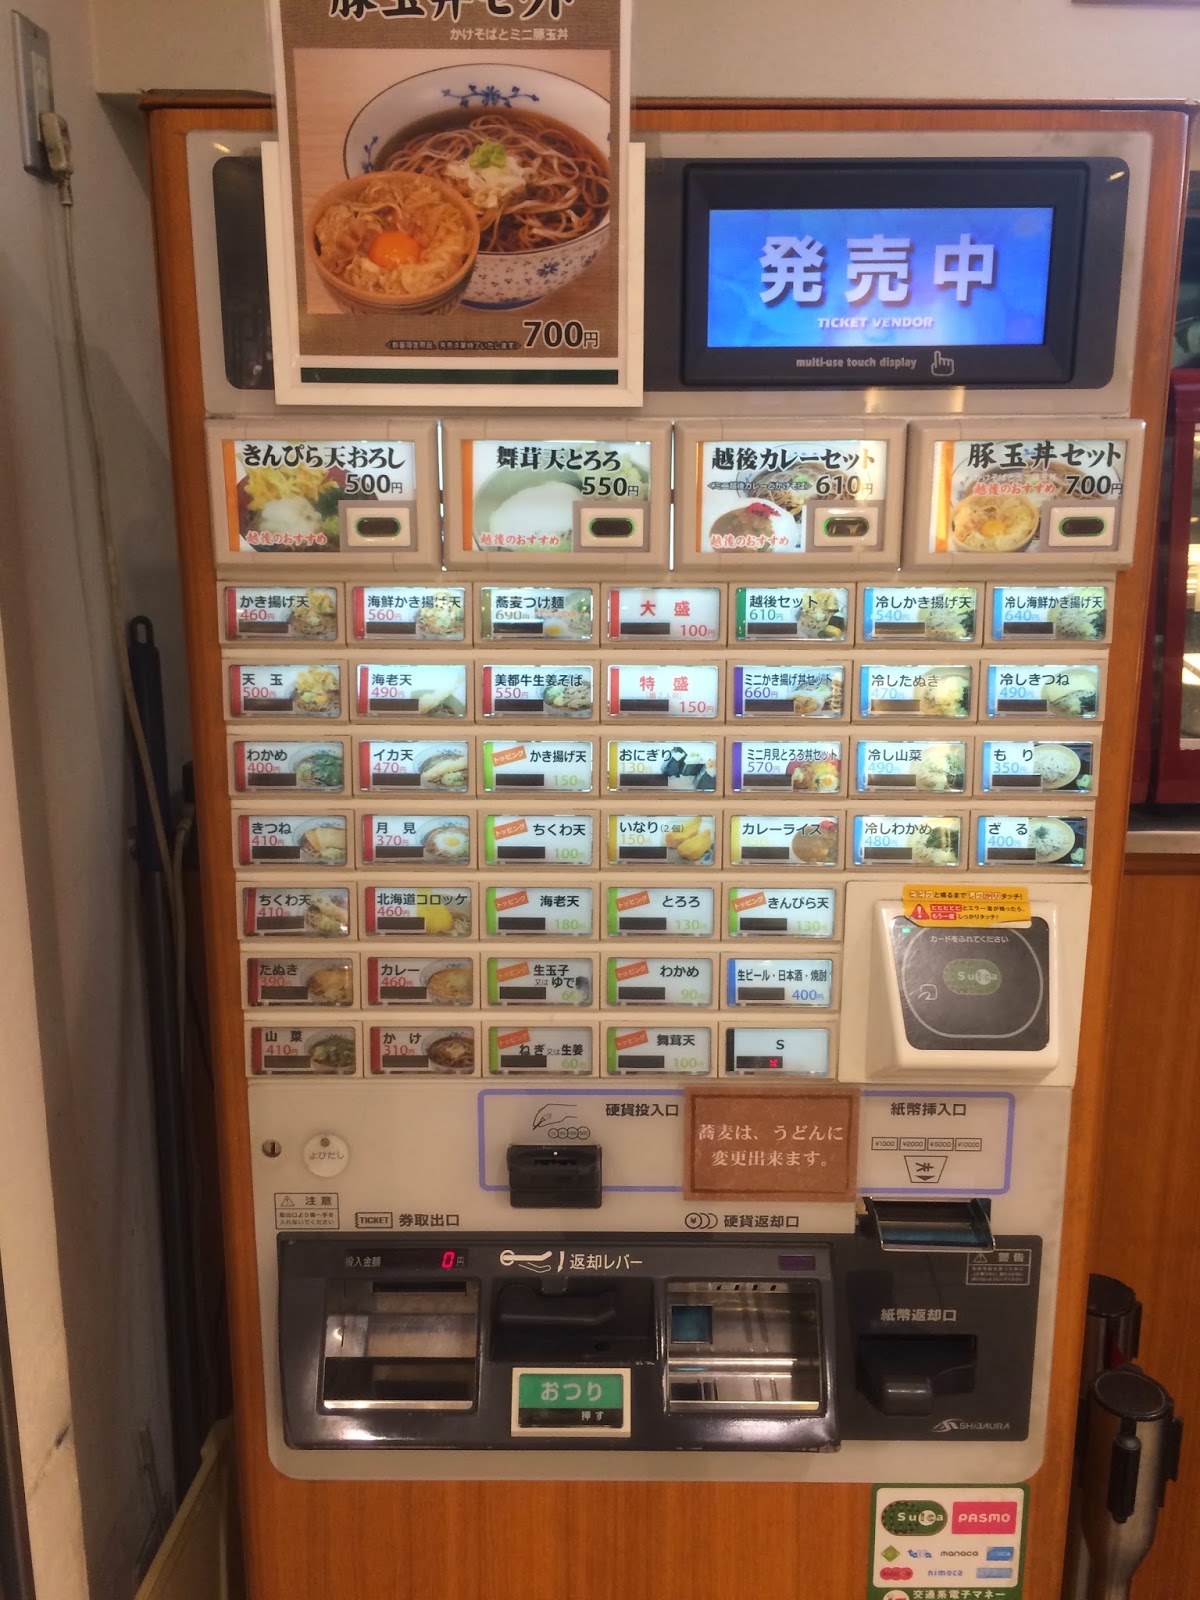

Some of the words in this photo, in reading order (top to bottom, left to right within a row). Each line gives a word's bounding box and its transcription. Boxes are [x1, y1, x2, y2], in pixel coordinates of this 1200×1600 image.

[758, 233, 997, 303] 発売中
[817, 317, 868, 329] TICKET
[872, 317, 934, 329] VENDOR
[523, 320, 600, 349] 700円
[795, 357, 844, 368] multi-use
[846, 357, 877, 368] touch
[879, 357, 917, 370] display
[243, 443, 406, 470] きんぴら天おろし
[496, 445, 622, 472] 舞茸天とろろ
[711, 441, 876, 471] 越後カレーセット
[967, 440, 1122, 470] 豚玉丼セット
[343, 473, 404, 495] 500円
[580, 475, 640, 498] 550円
[814, 474, 874, 496] 610円
[974, 482, 1057, 496] 越後のおすすめ
[1065, 475, 1123, 496] 700円
[246, 532, 328, 545] 越後のおすすめ
[479, 532, 560, 546] 越後のおすすめ
[709, 533, 790, 548] 越後のおすすめ
[239, 595, 310, 609] かき揚げ天
[367, 595, 462, 609] 海鮮かき揚げ天
[749, 595, 819, 608] 越後セット
[875, 595, 973, 610] 冷しかき揚げ天
[1004, 595, 1103, 610] 冷し海鮮かき揚げ天
[240, 609, 275, 621] 460円
[367, 609, 401, 621] 560円
[639, 600, 691, 617] 大盛
[749, 609, 784, 621] 610円
[680, 624, 716, 637] 100円
[242, 673, 284, 686] 天玉
[371, 673, 413, 686] 海老天
[494, 673, 583, 687] 美都牛生姜そば
[639, 675, 689, 692] 特盛
[744, 673, 833, 687] ミニかき揚げ丼セット
[871, 674, 940, 687] 冷したぬき
[999, 673, 1070, 686] 冷しきつね
[242, 687, 276, 698] 500円
[495, 687, 529, 699] 550円
[744, 687, 779, 699] 660円
[679, 701, 714, 713] 150円
[246, 749, 288, 761] わかめ
[373, 749, 414, 761] イカ天
[529, 750, 587, 763] かき揚げ天
[619, 749, 672, 762] おにぎり
[746, 748, 838, 761] ミニ月見とろろ丼セット
[867, 749, 923, 762] 冷し山菜
[993, 749, 1034, 762] もり
[247, 762, 282, 773] 400円
[747, 762, 781, 773] 570円
[251, 822, 292, 834] きつね
[376, 821, 417, 835] 月見
[532, 823, 586, 837] ちくわ天
[742, 822, 822, 836] カレーライス
[864, 822, 933, 836] 冷しわかめ
[987, 822, 1029, 836] ざる
[251, 835, 285, 847] 410円
[376, 835, 410, 846] 370円
[259, 894, 312, 906] ちくわ天
[377, 893, 468, 906] 北海道コロッケ
[540, 895, 580, 908] 海老天
[662, 896, 701, 908] とろろ
[767, 897, 830, 910] きんぴら天
[377, 907, 410, 917] 460円
[929, 935, 1009, 944] カードをふれてください
[259, 964, 298, 976] たぬき
[380, 963, 420, 976] カレー
[533, 964, 570, 976] 生玉子
[660, 965, 700, 978] わかめ
[791, 988, 825, 1001] 400円
[265, 1030, 303, 1043] 山菜
[383, 1032, 422, 1044] かけ
[656, 1034, 696, 1047] 舞茸天
[266, 1044, 299, 1056] 410円
[383, 1044, 416, 1056] 310円
[775, 1039, 785, 1050] S
[605, 1103, 679, 1117] 硬貨投入口
[889, 1102, 967, 1117] 紙幣挿入口
[698, 1124, 844, 1141] 蕎麦は、うどんに
[309, 1151, 345, 1160] よびだし
[711, 1150, 829, 1168] 変更出来ます。
[305, 1196, 333, 1206] 注意
[360, 1216, 390, 1224] TICKET
[398, 1212, 460, 1228] 券取出口
[723, 1214, 800, 1229] 硬貨返却口
[345, 1255, 382, 1268] 投入金額
[569, 1253, 643, 1271] 返却レバー
[880, 1308, 957, 1323] 紙幣返却口
[540, 1381, 603, 1401] おつり
[581, 1410, 605, 1421] 押す
[897, 1512, 944, 1522] Suica
[957, 1513, 1012, 1523] PASMO
[927, 1569, 963, 1577] nimoca
[912, 1589, 1006, 1600] 交通系電子マネー
